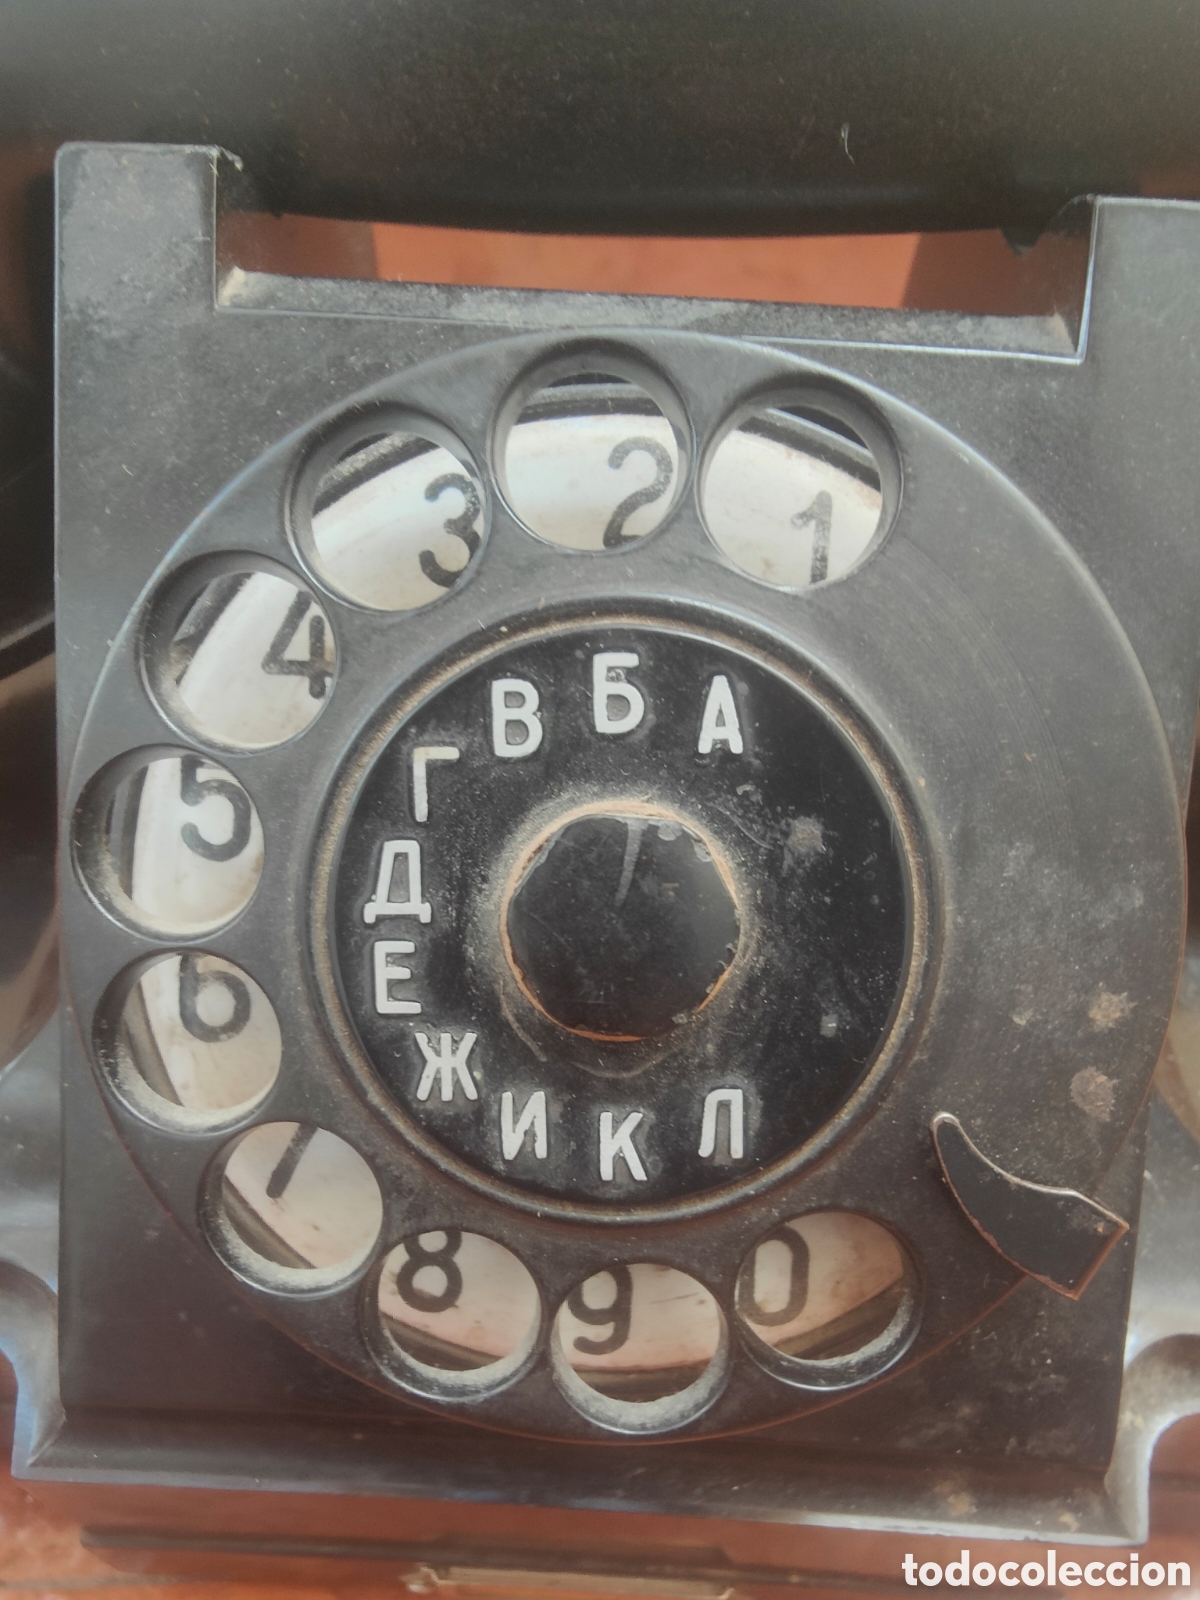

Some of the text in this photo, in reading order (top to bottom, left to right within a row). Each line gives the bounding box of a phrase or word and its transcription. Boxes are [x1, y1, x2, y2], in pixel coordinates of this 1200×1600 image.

[418, 471, 485, 589] 3
[603, 436, 673, 549] 2
[791, 490, 832, 584] 1
[261, 590, 336, 699] 4
[491, 678, 543, 758] В
[593, 652, 645, 733] Б
[698, 675, 743, 754] А
[180, 756, 252, 861] 5
[413, 746, 460, 822] Г
[364, 840, 431, 923] Д
[178, 953, 251, 1043] 6
[374, 940, 422, 1014] Е
[415, 1032, 478, 1101] Ж
[501, 1091, 547, 1160] И
[599, 1112, 648, 1181] К
[699, 1088, 743, 1159] Л
[397, 1230, 462, 1312] 8
[568, 1263, 632, 1355] 9
[737, 1224, 810, 1327] 0
